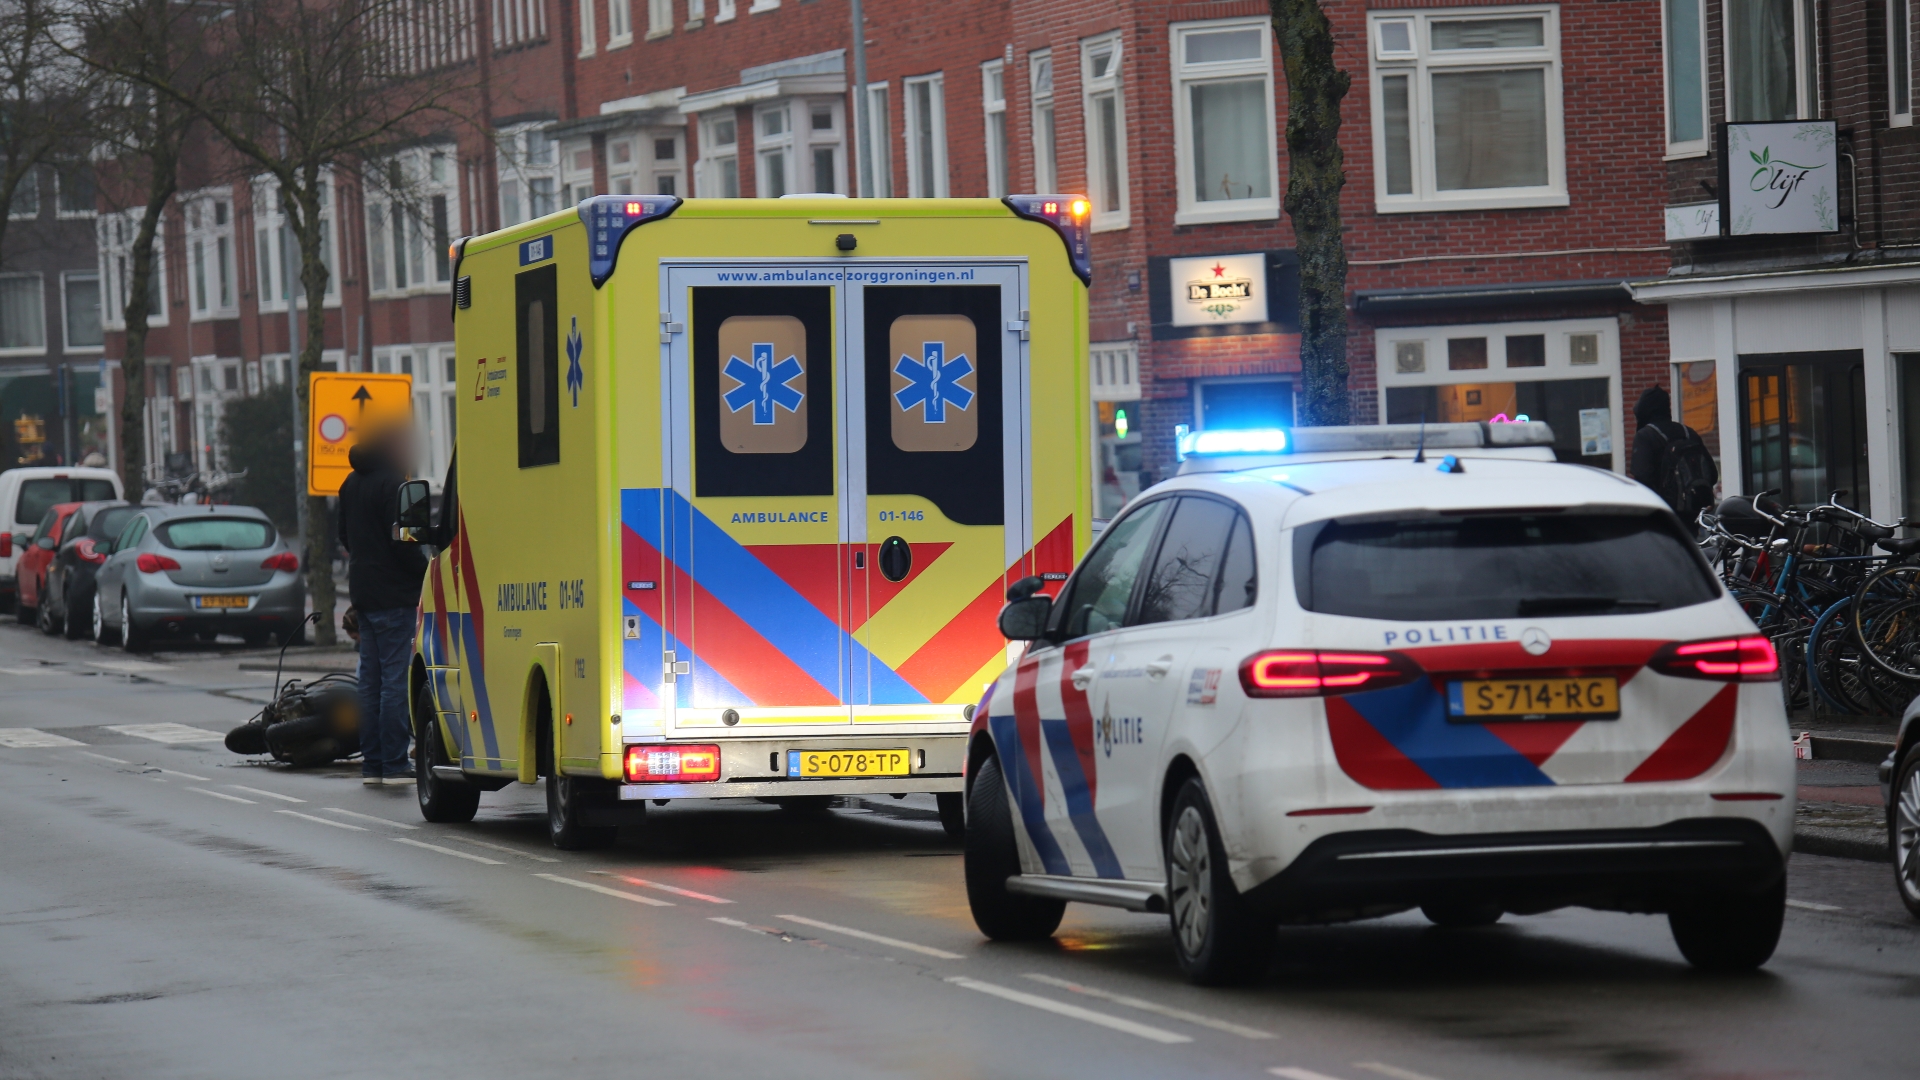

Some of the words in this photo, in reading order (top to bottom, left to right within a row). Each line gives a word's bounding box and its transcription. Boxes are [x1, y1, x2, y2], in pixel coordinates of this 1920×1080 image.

[1750, 165, 1809, 209] Olijf
[718, 269, 974, 283] www.ambulancezorggroningen.nl
[1191, 285, 1208, 299] De
[1210, 283, 1246, 298] Bocht
[731, 511, 829, 524] AMBULANCE
[879, 509, 925, 522] 01-146
[498, 582, 547, 611] AMBULANCE
[560, 579, 584, 609] 01-146
[1385, 626, 1509, 646] POLITIE
[1477, 683, 1604, 710] S-714-RG
[808, 754, 901, 773] S-078-TP
